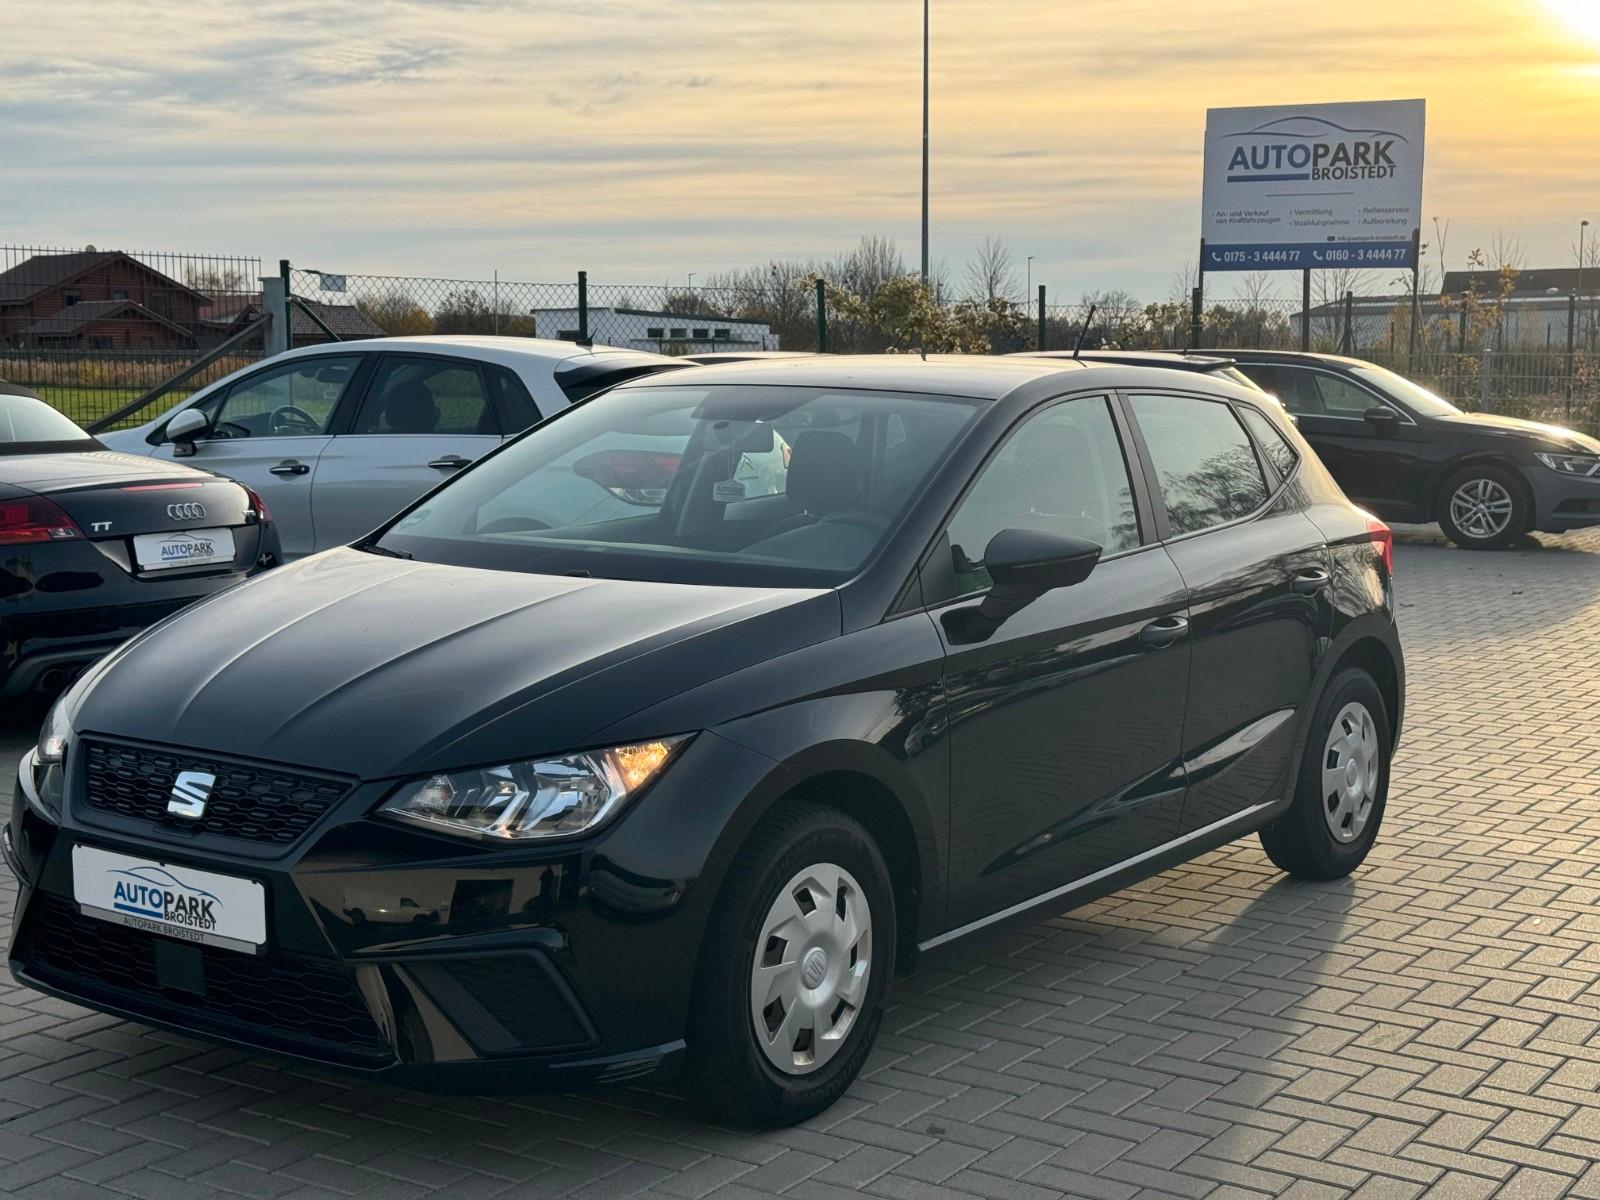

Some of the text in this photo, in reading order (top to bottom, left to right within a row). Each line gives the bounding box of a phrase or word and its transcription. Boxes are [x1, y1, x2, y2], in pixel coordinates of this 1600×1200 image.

[1227, 140, 1396, 171] AUTOPARK
[1312, 165, 1396, 181] BROISTEDT
[1243, 208, 1269, 217] Verkauf
[1294, 208, 1334, 216] Vermittlung
[1362, 217, 1407, 226] Aufbereitung
[1223, 251, 1246, 262] 0175
[1254, 251, 1260, 262] 3
[1325, 249, 1349, 261] 0160
[1357, 249, 1364, 260] 3
[91, 521, 113, 532] TT
[161, 541, 215, 557] AUTOPARK
[113, 880, 217, 922] AUTOPARK
[164, 910, 217, 931] BROISTEDT
[123, 916, 205, 942] AUTOPARK BROISTEDT
